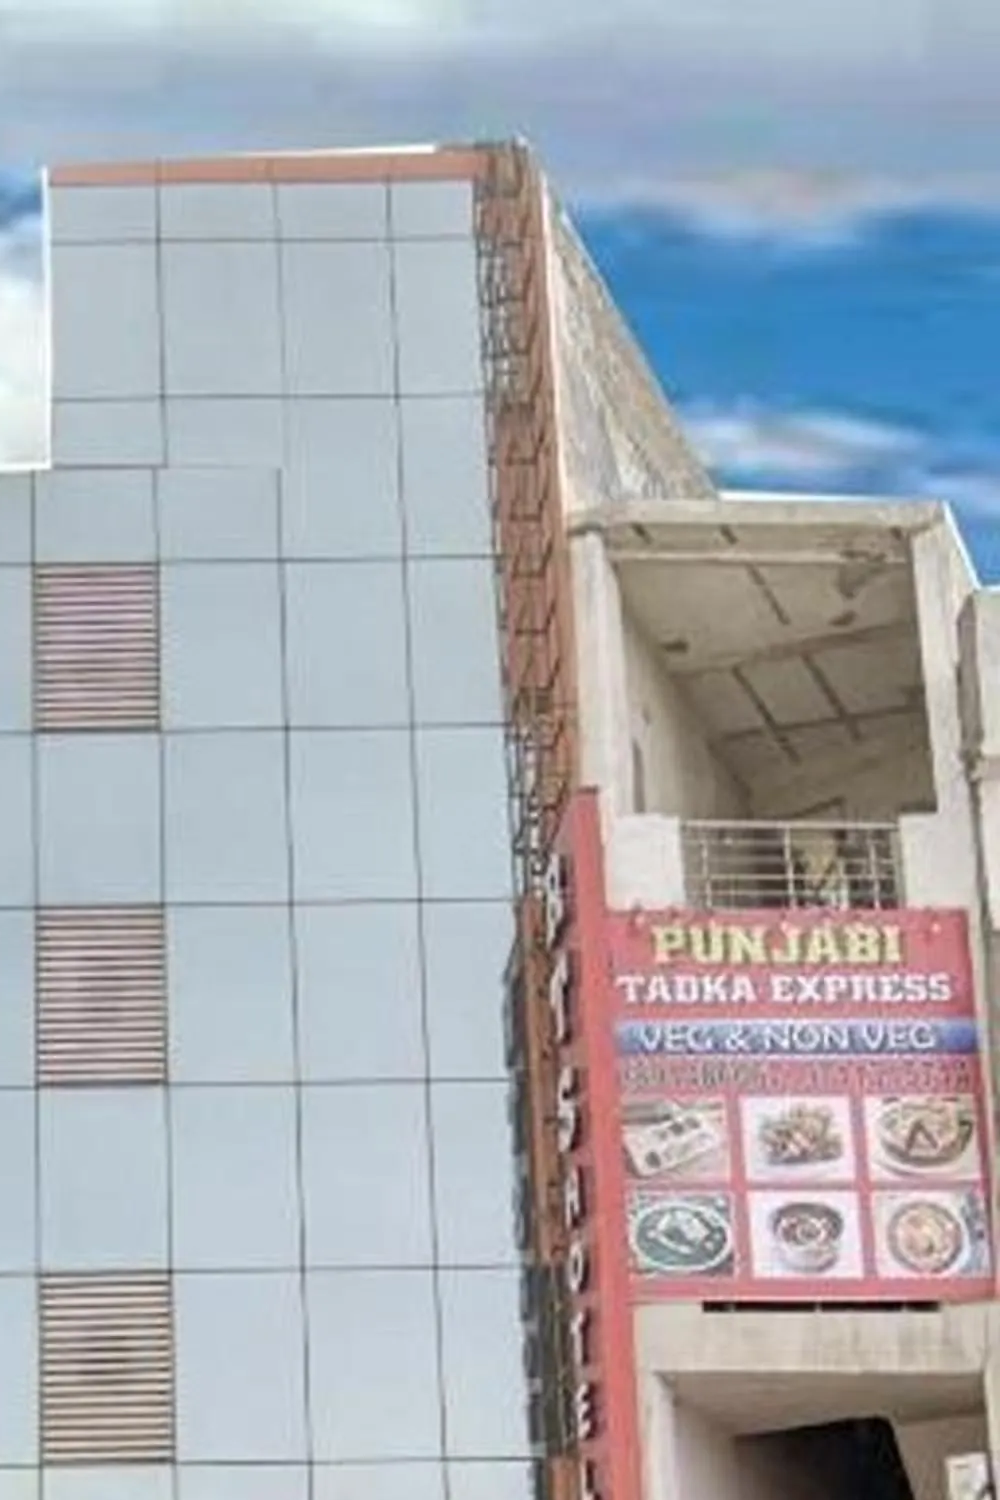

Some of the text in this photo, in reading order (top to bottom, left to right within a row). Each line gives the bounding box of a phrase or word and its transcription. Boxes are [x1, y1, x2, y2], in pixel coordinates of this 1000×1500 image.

[651, 924, 904, 964] PUNJABI
[615, 972, 953, 1004] TADKA EXPRESS
[638, 1022, 936, 1051] VEG & NON VEG
